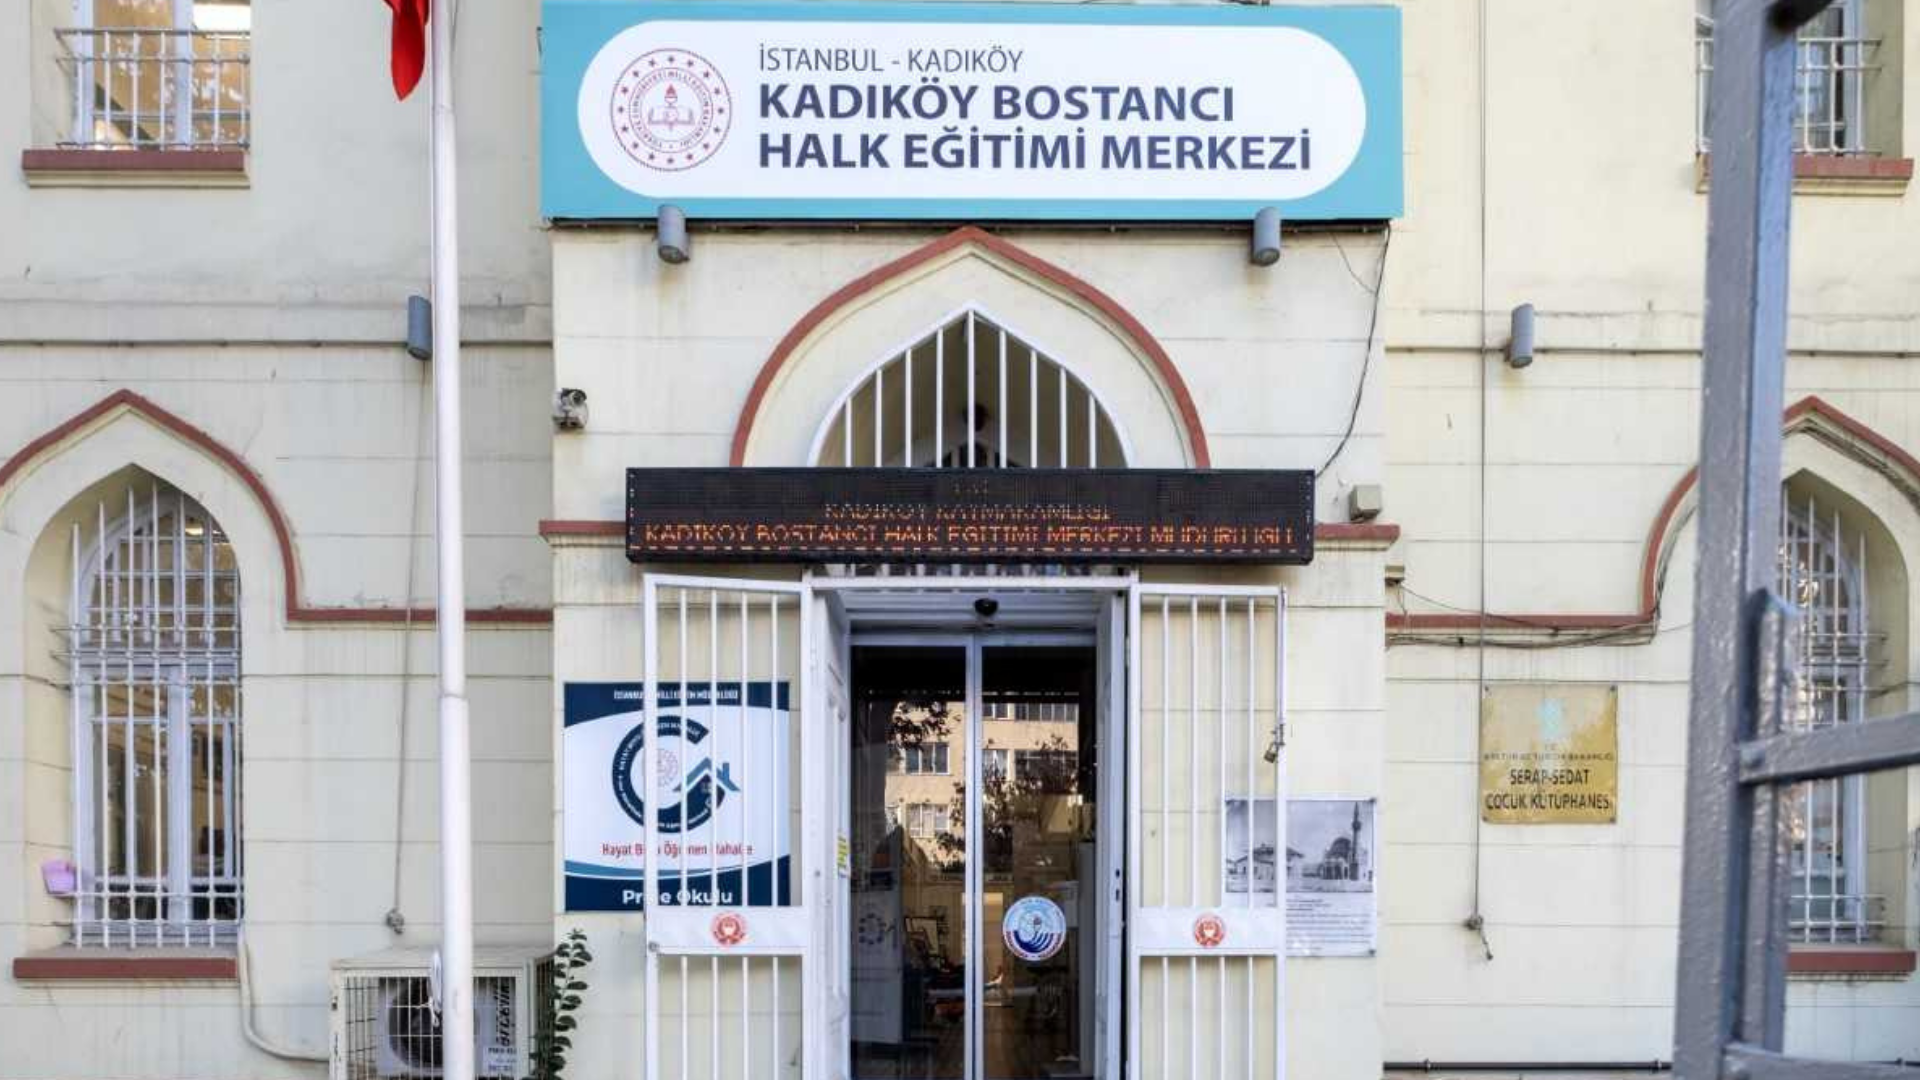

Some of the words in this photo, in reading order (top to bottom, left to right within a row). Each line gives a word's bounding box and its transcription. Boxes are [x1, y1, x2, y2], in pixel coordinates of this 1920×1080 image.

[760, 43, 884, 72] İSTANBUL
[908, 45, 1024, 73] KADIKÖY
[760, 76, 979, 120] KADIKÖY
[994, 84, 1234, 122] BOSTANCI
[760, 133, 890, 169] HALK
[904, 126, 1086, 170] EĞİTİMİ
[1101, 128, 1311, 171] MERKEZİ
[1510, 769, 1589, 785] SERAP-SEDAT
[602, 843, 632, 858] Hayat
[622, 889, 671, 904] Pre
